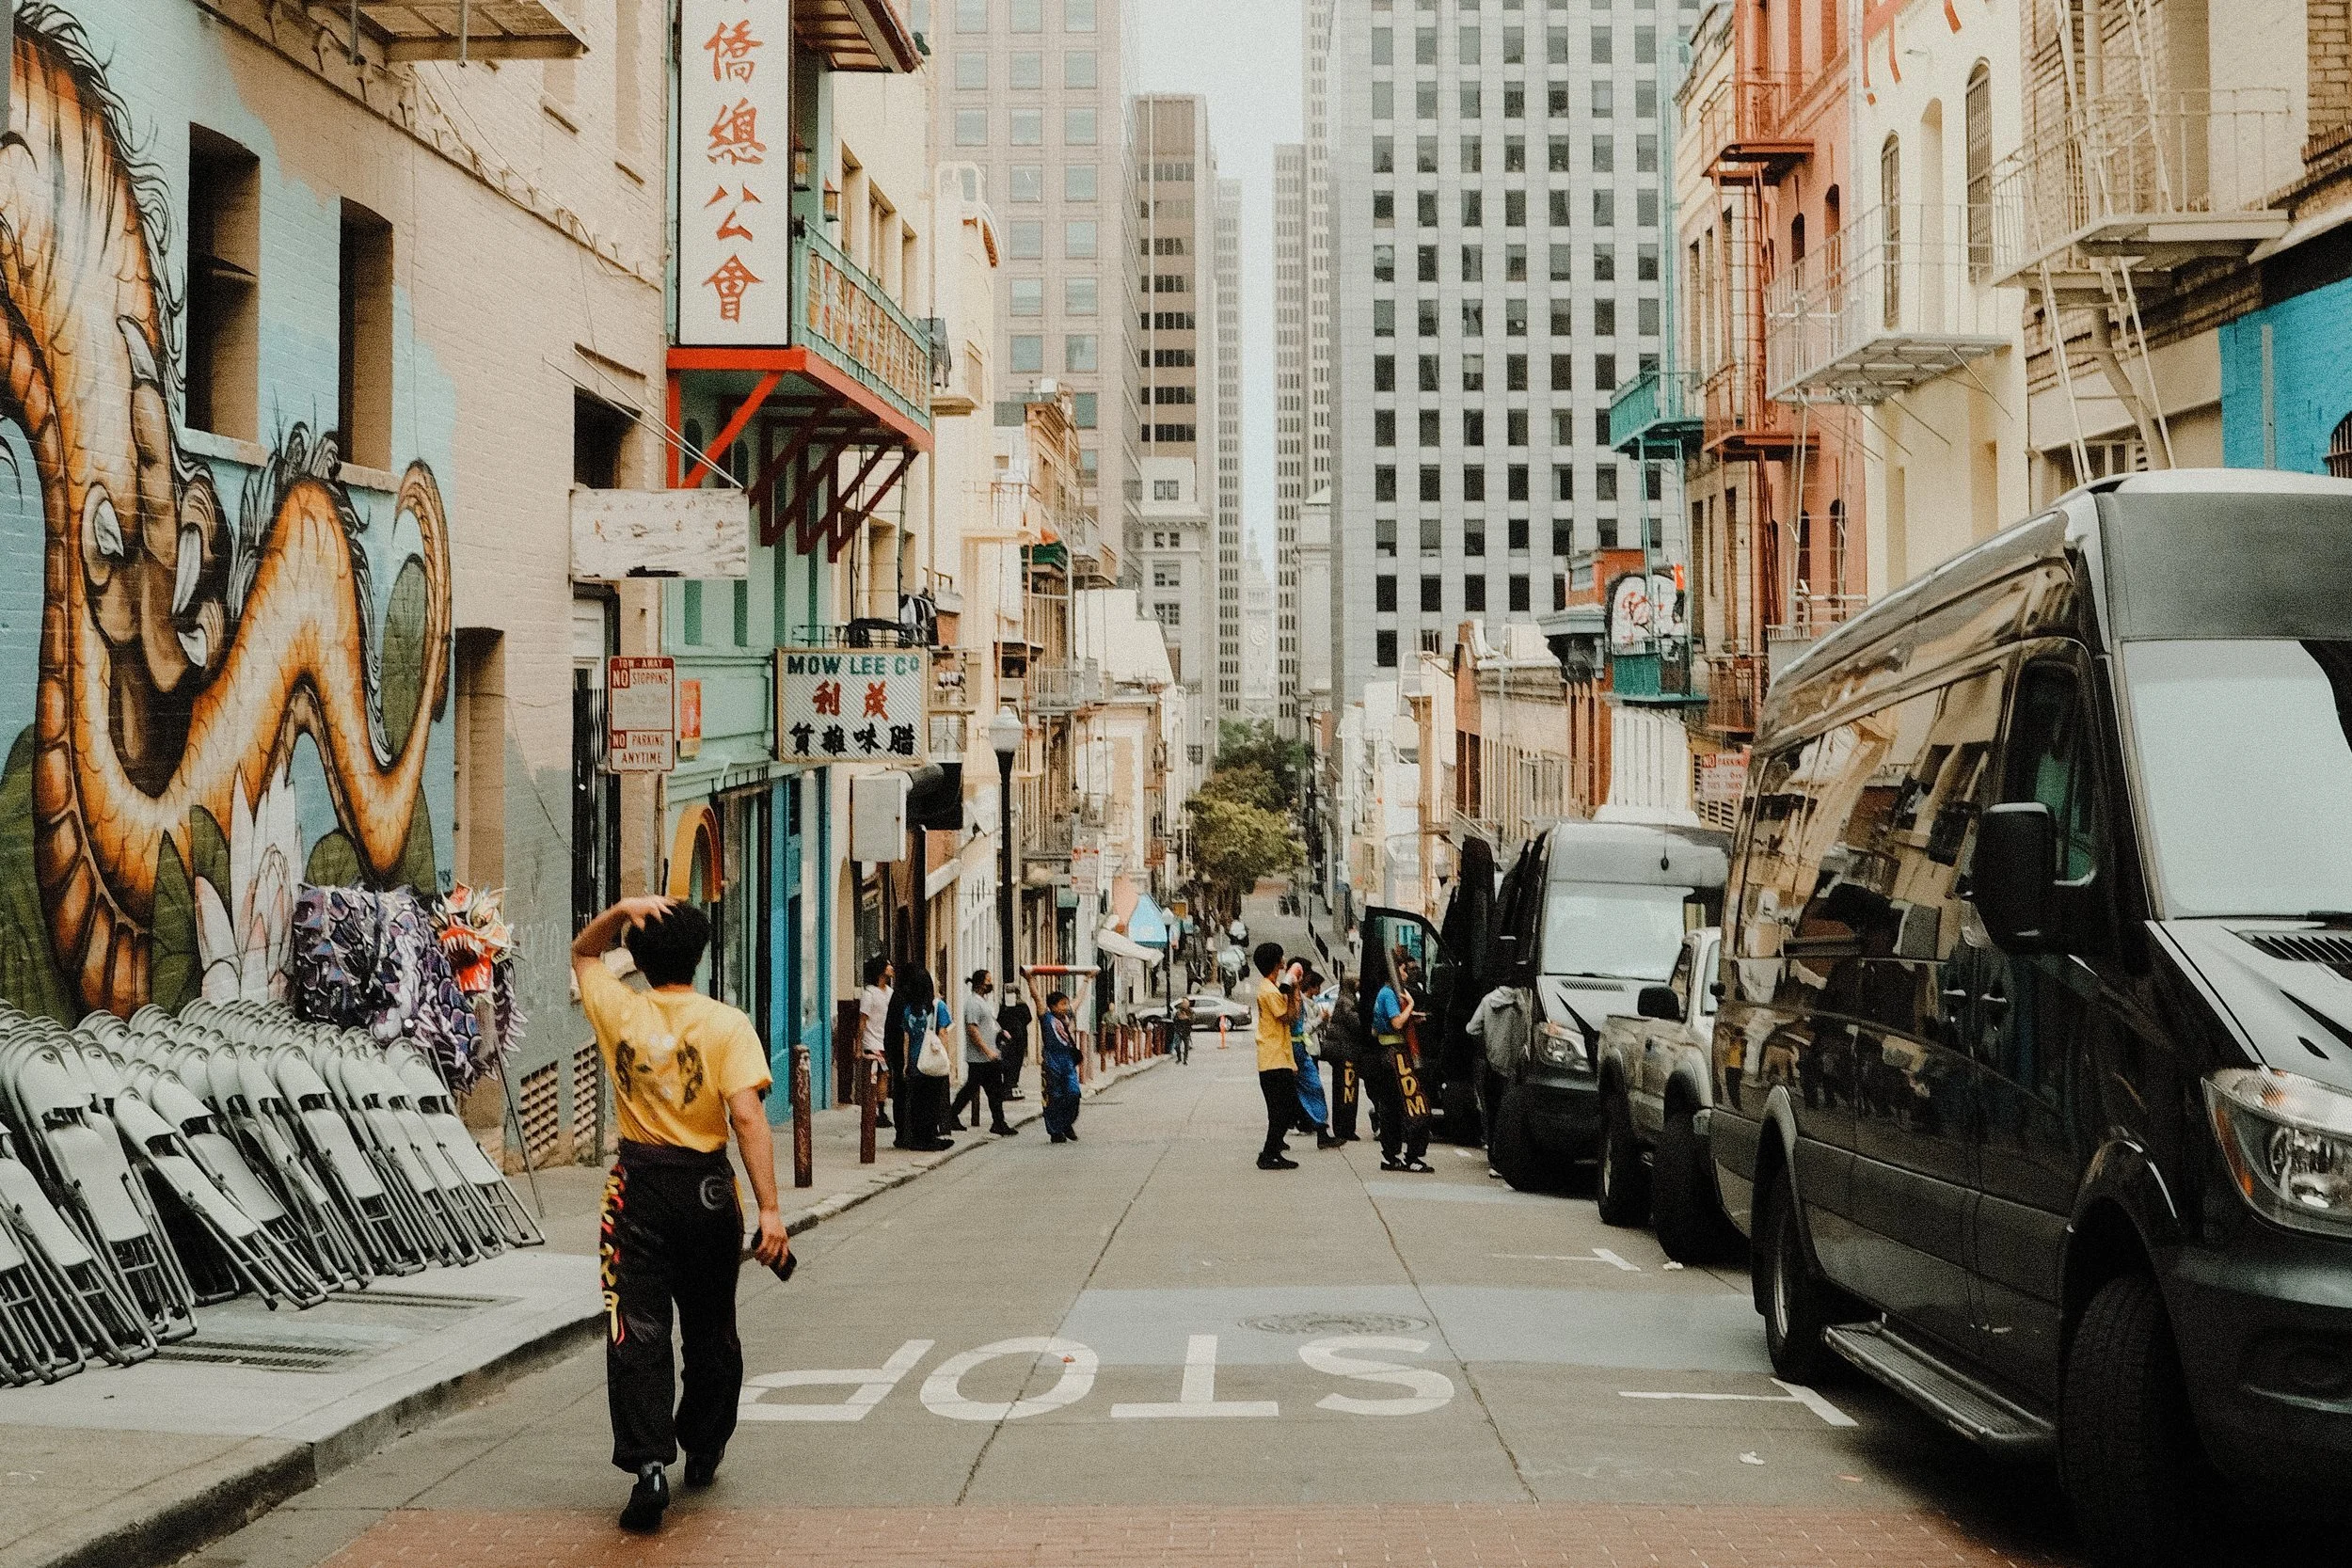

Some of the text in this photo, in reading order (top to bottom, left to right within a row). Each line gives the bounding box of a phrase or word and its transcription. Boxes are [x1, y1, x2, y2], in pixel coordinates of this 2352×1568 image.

[702, 0, 765, 325] 僑總公會
[787, 656, 841, 674] MOW
[850, 657, 885, 674] LEE
[612, 669, 668, 688] NO STOPPING
[612, 734, 664, 748] NO PARKING
[622, 752, 662, 764] ANYTIME
[1703, 753, 1716, 767] NO
[737, 1334, 1454, 1421] STOP
